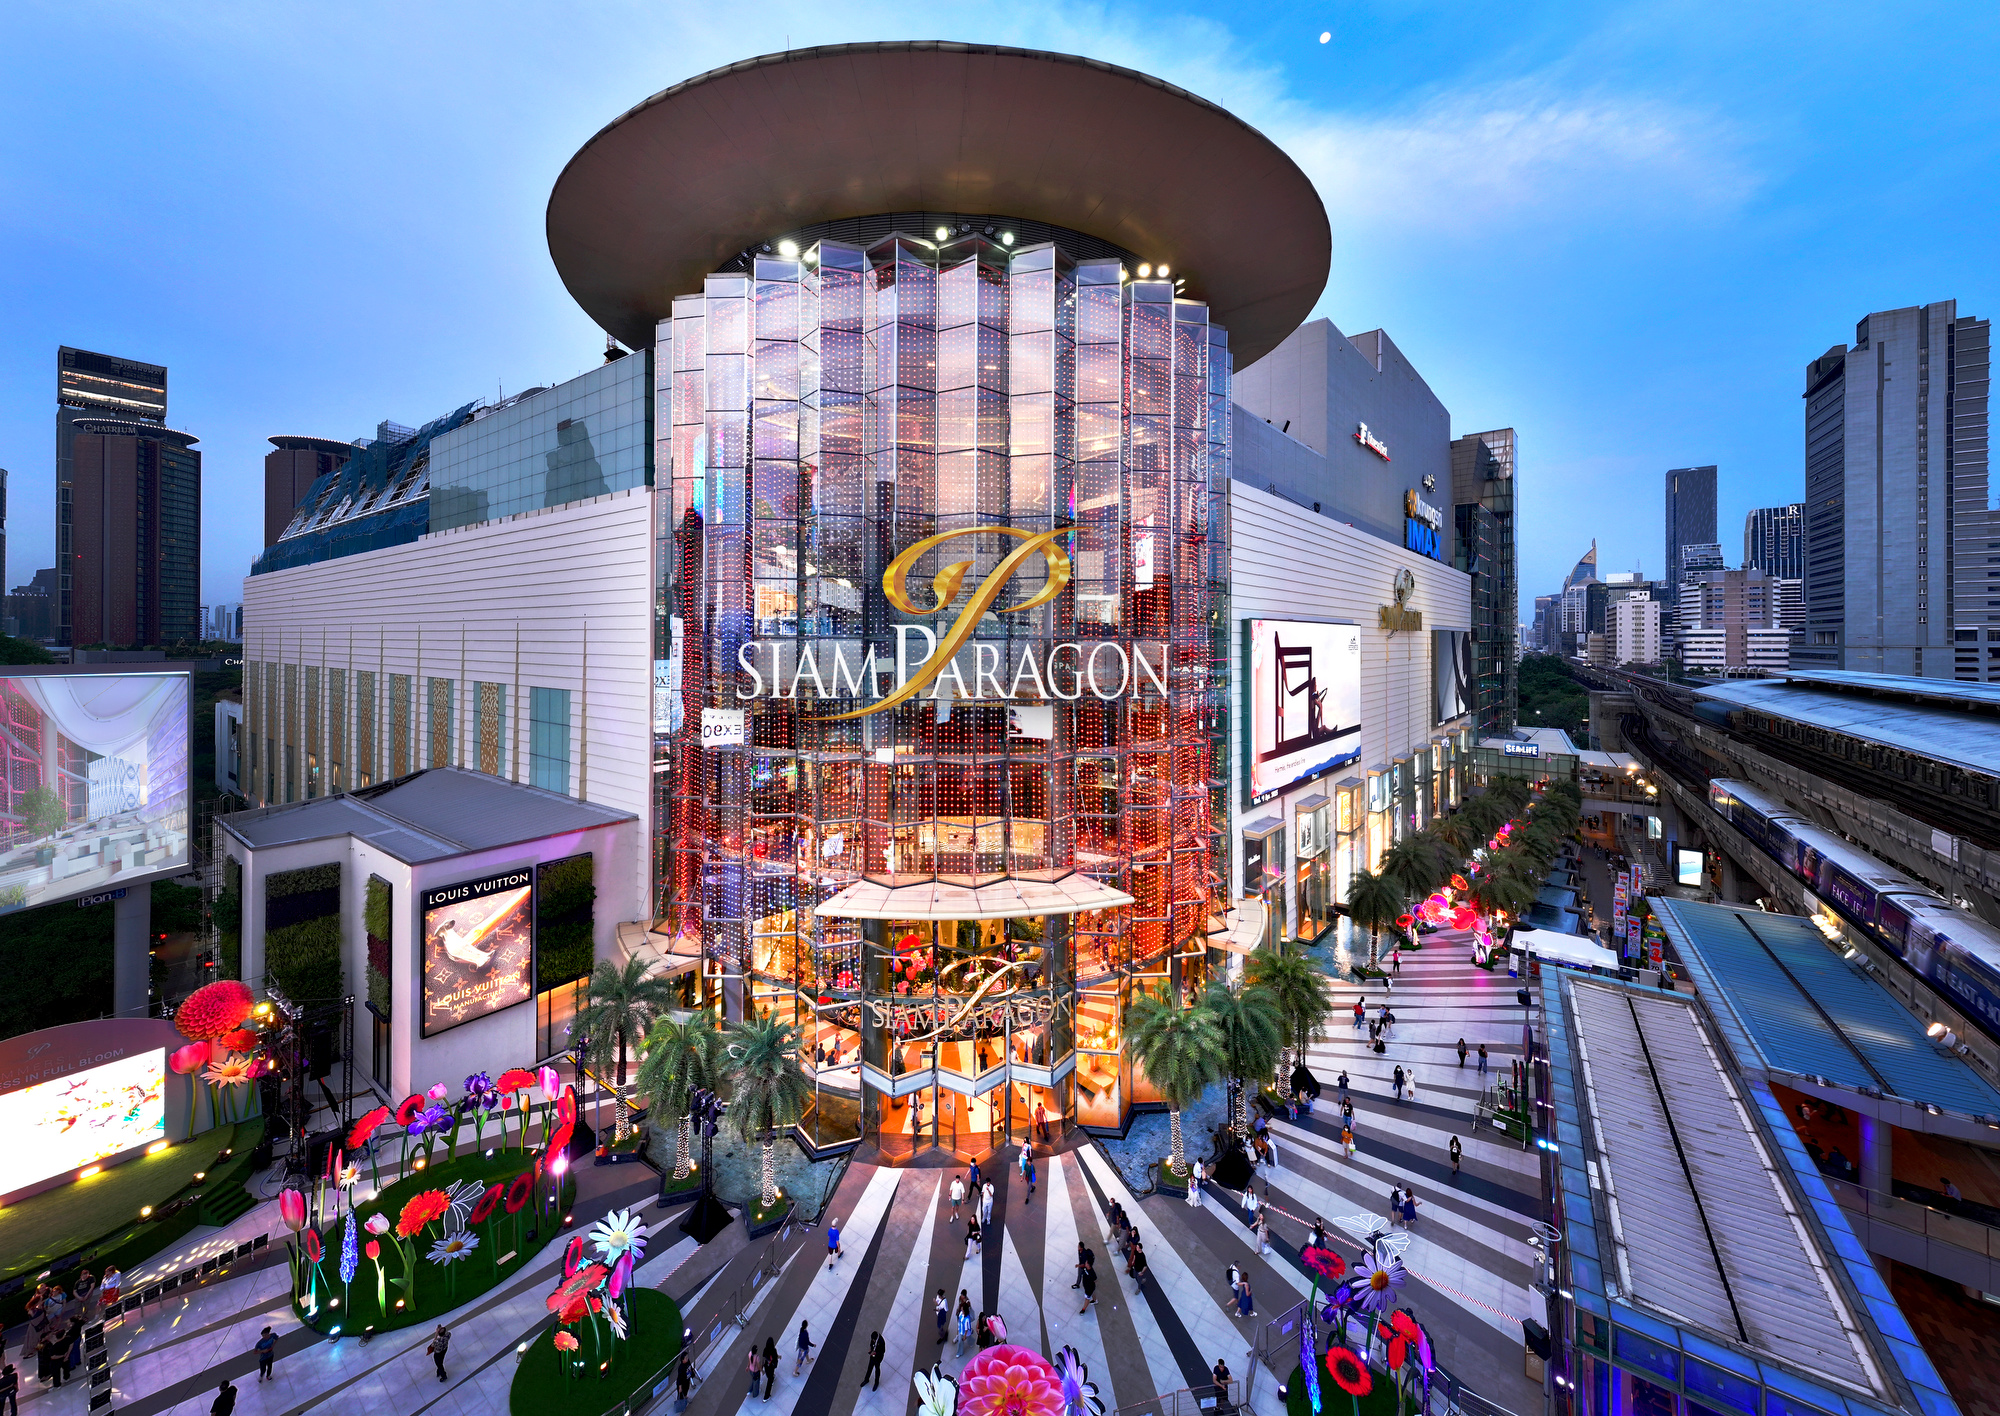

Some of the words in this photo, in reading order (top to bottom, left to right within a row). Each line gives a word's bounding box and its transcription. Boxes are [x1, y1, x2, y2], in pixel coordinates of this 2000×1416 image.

[84, 424, 136, 434] CHATRIUM
[1406, 518, 1441, 560] IMAX
[736, 642, 884, 699] SIAM
[889, 625, 1170, 699] PARAGON
[429, 886, 469, 905] LOUIS
[474, 872, 529, 894] VUITTON
[1832, 884, 1849, 906] FACE
[437, 985, 472, 1007] LOUIS
[474, 970, 521, 995] VUITTON
[872, 999, 935, 1030] SIAM
[943, 995, 1074, 1031] PARAGON
[25, 1072, 39, 1082] IN
[43, 1063, 76, 1077] FULL
[79, 1048, 124, 1067] BLOOM
